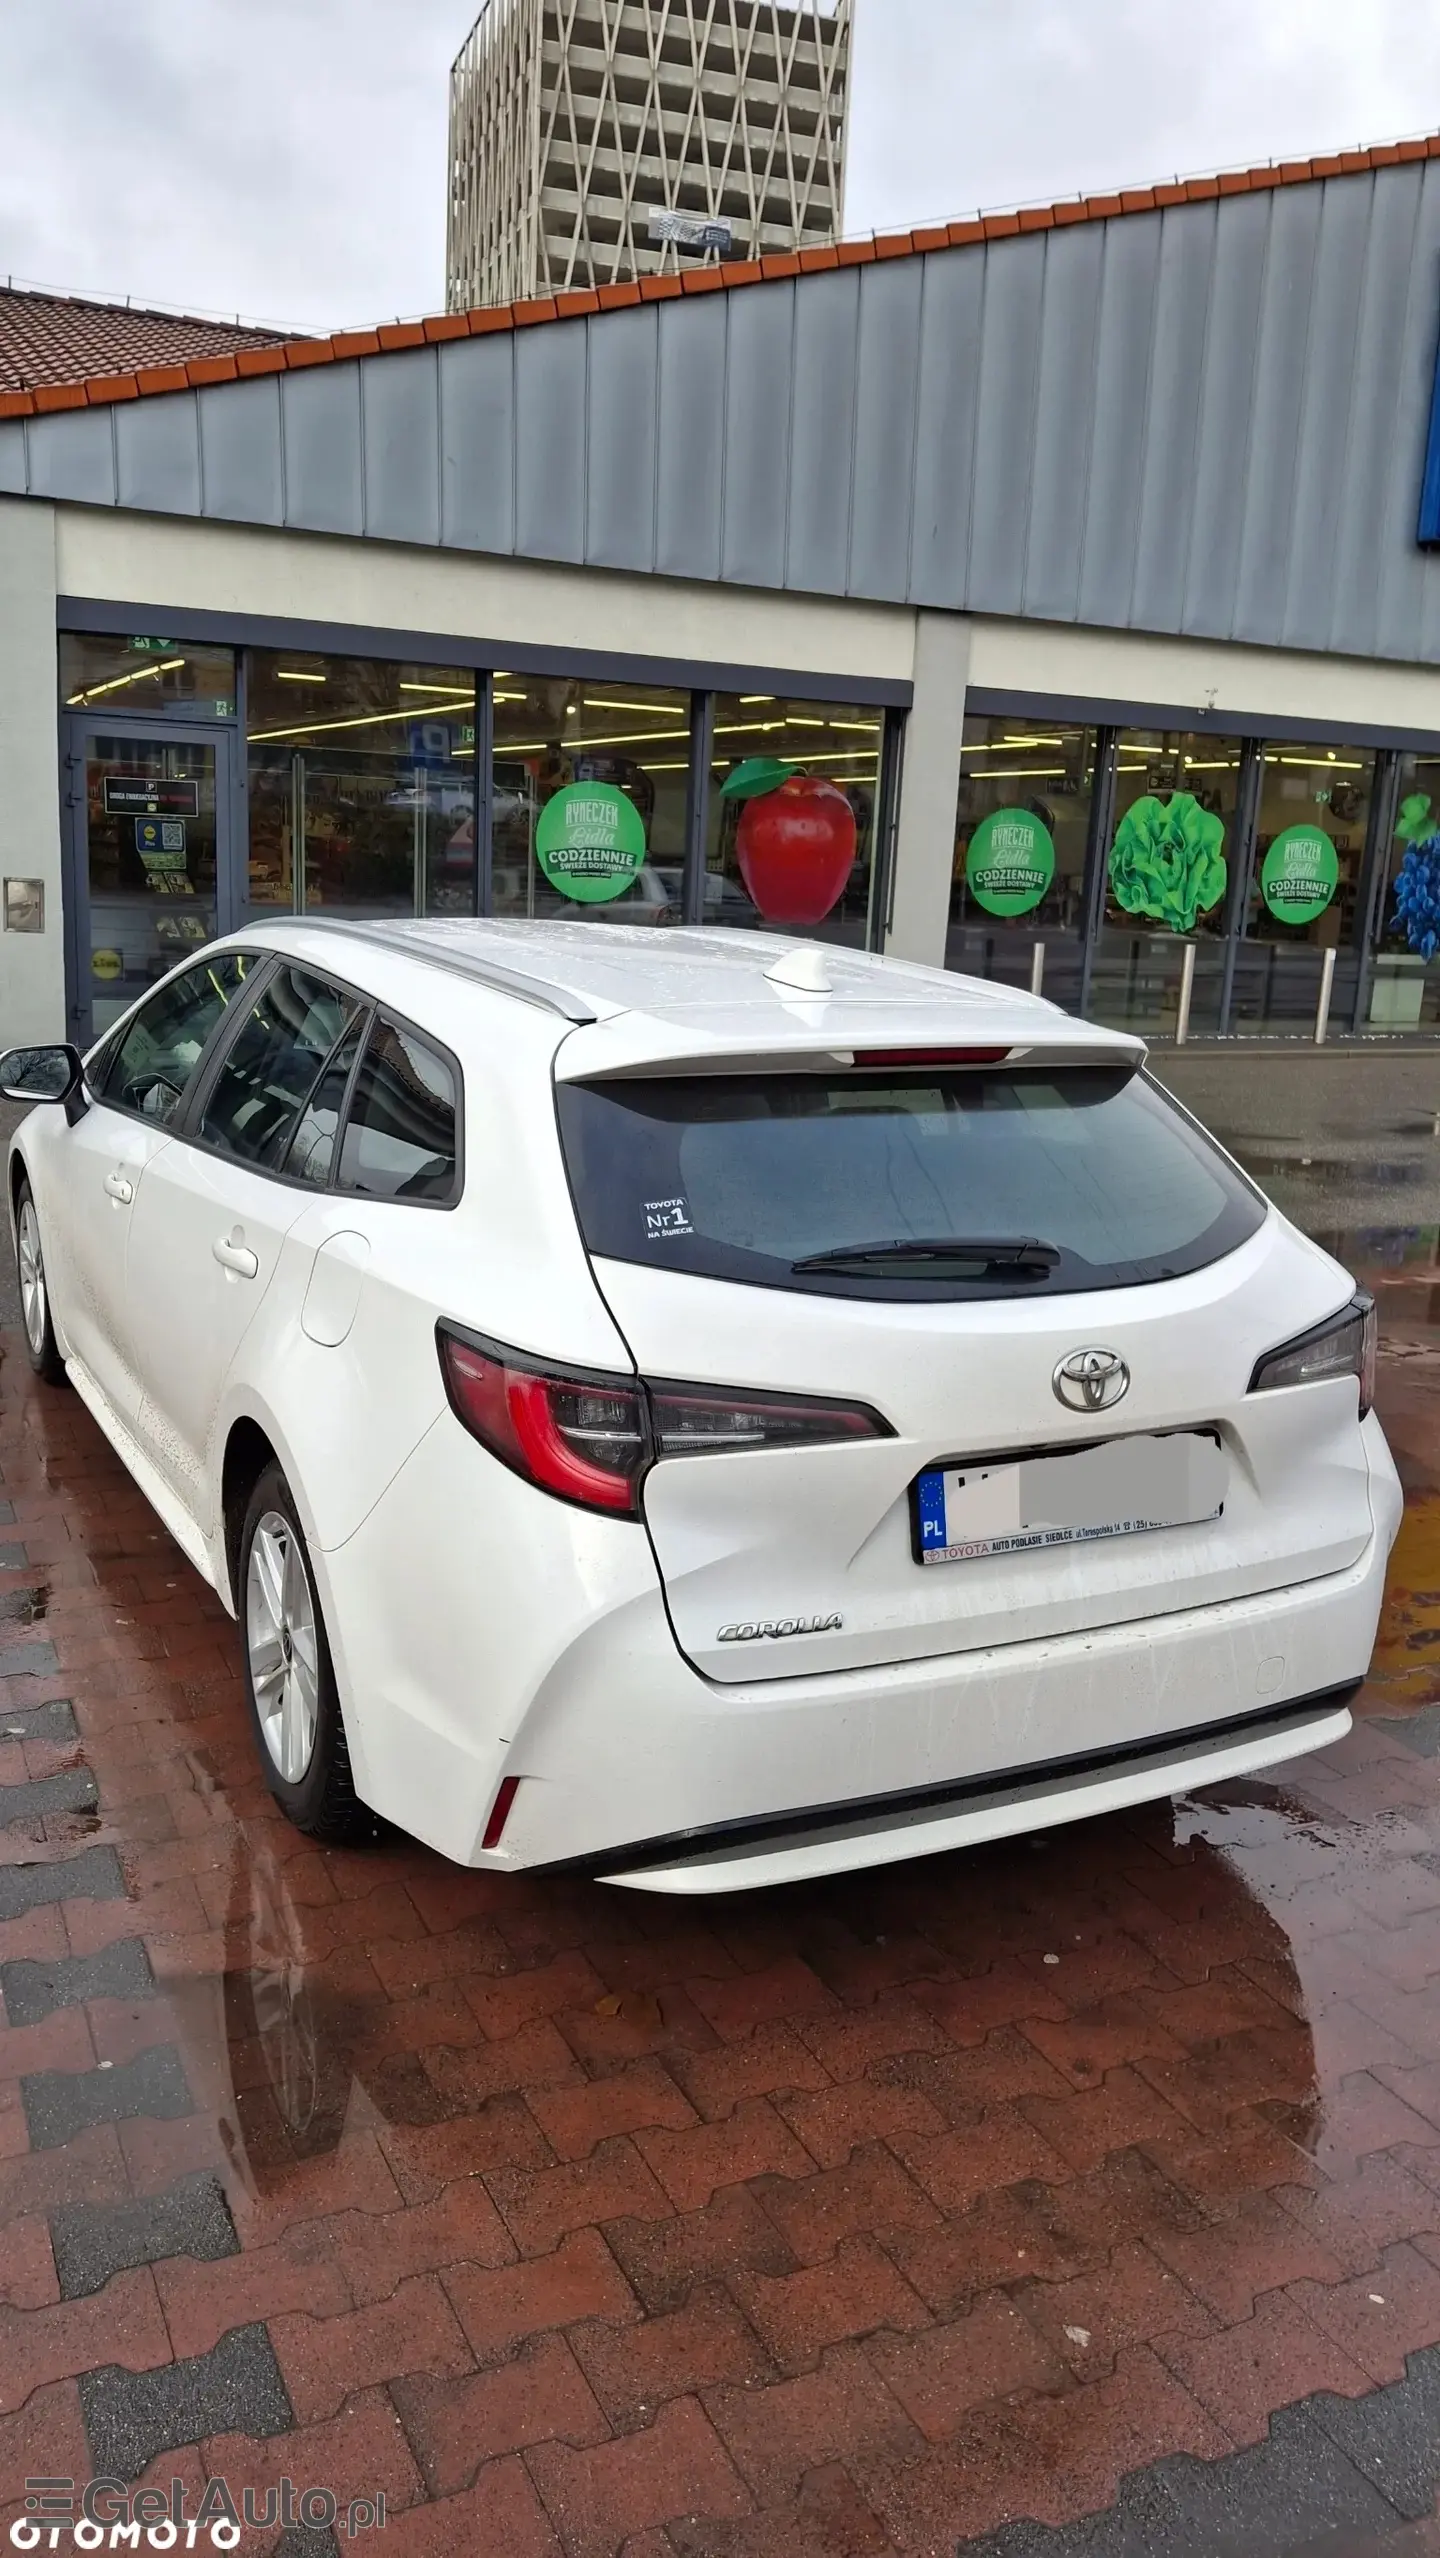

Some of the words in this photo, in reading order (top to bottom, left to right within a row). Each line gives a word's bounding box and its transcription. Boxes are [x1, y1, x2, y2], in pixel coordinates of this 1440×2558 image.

[565, 802, 618, 826] RYNECZEK
[569, 827, 615, 848] Lidla
[548, 849, 635, 866] CODZIENNIE
[589, 862, 624, 872] DOSTAWY
[975, 869, 1045, 884] CODZIENNIE
[1269, 880, 1330, 894] CODZIENNIE
[643, 1199, 684, 1210] TOYOTA
[646, 1214, 670, 1228] Nr
[670, 1207, 689, 1226] 1
[647, 1231, 660, 1239] NA
[661, 1226, 694, 1237] ŚWIECIE
[923, 1520, 943, 1538] PL
[942, 1543, 990, 1560] TOYOTA
[991, 1537, 1011, 1552] AUTO
[1010, 1532, 1043, 1549] PODLASIE
[1044, 1528, 1074, 1544] SIEDLCE
[716, 1611, 844, 1642] COROLLA
